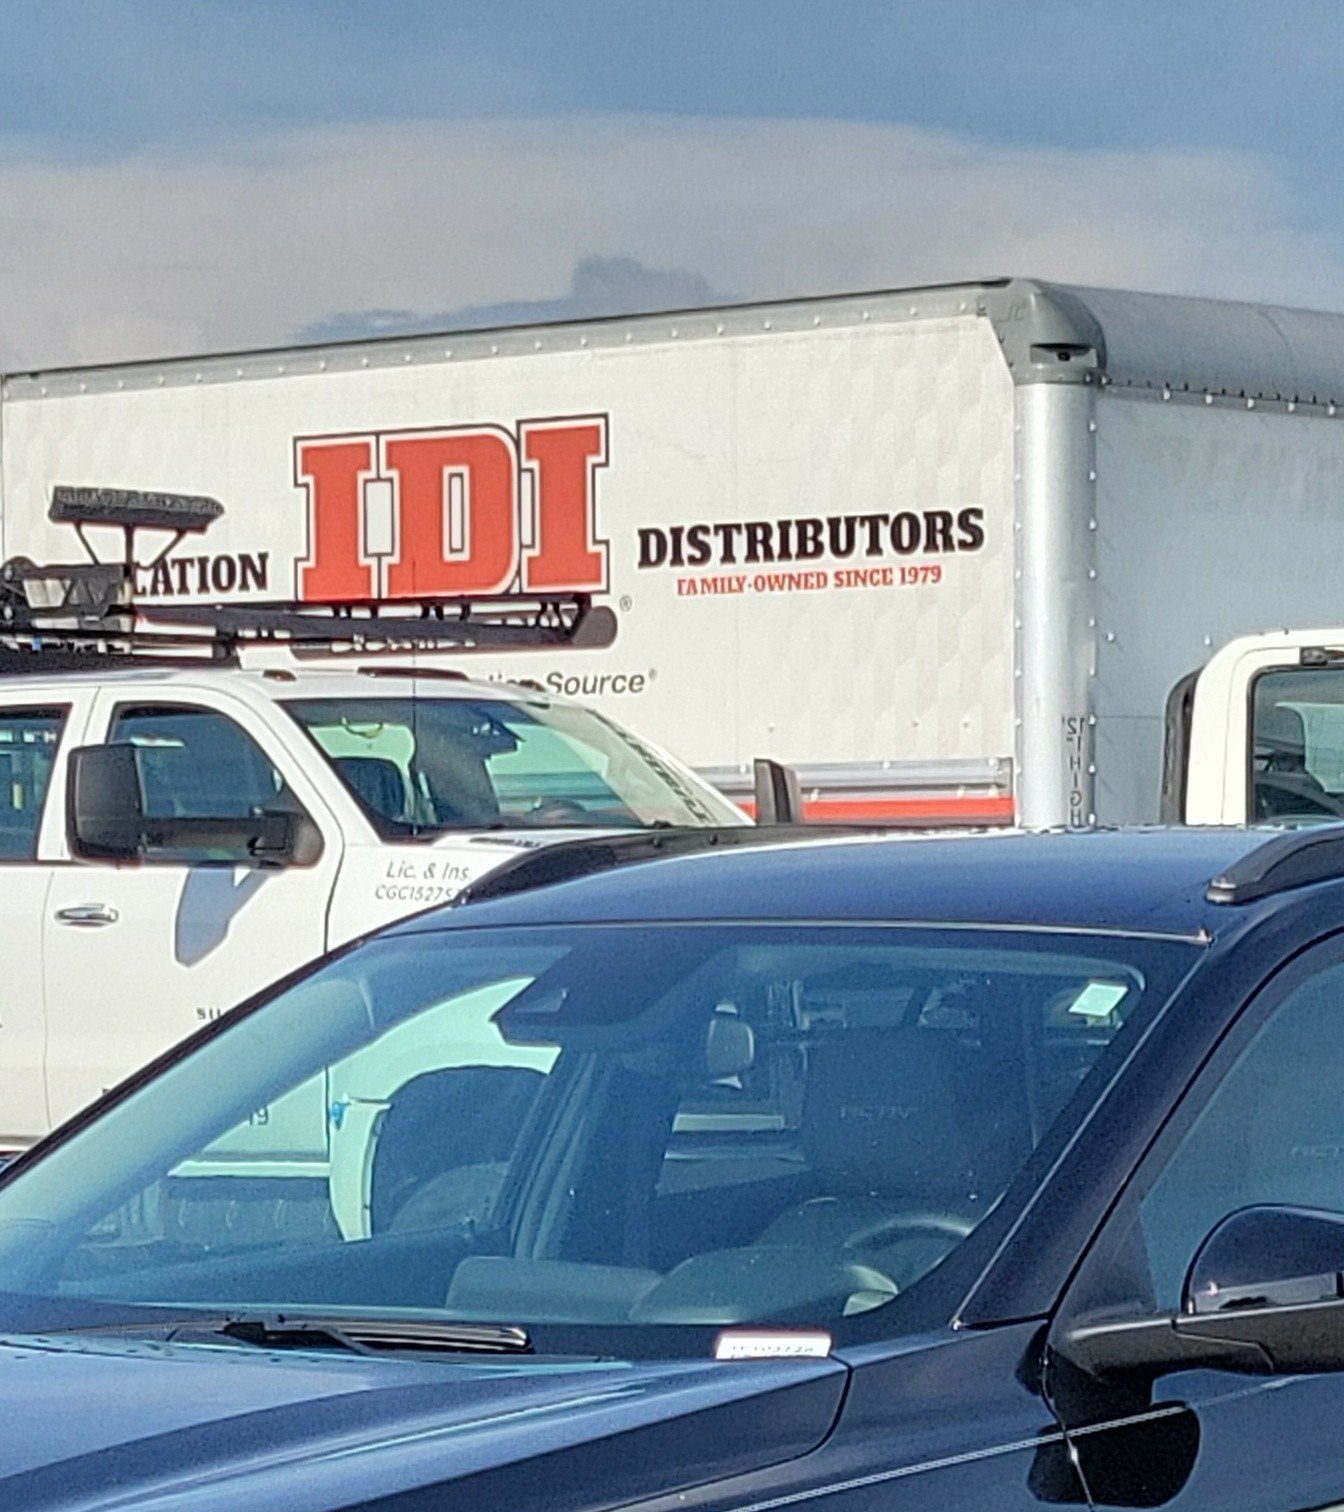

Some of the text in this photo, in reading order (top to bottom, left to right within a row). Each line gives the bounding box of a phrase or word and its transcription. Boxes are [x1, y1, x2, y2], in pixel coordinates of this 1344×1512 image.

[293, 413, 609, 601] IDI
[637, 507, 985, 569] DISTRIBUTORS
[676, 564, 942, 596] FAMILY-OWNED SINCE 1979
[423, 862, 437, 879] &
